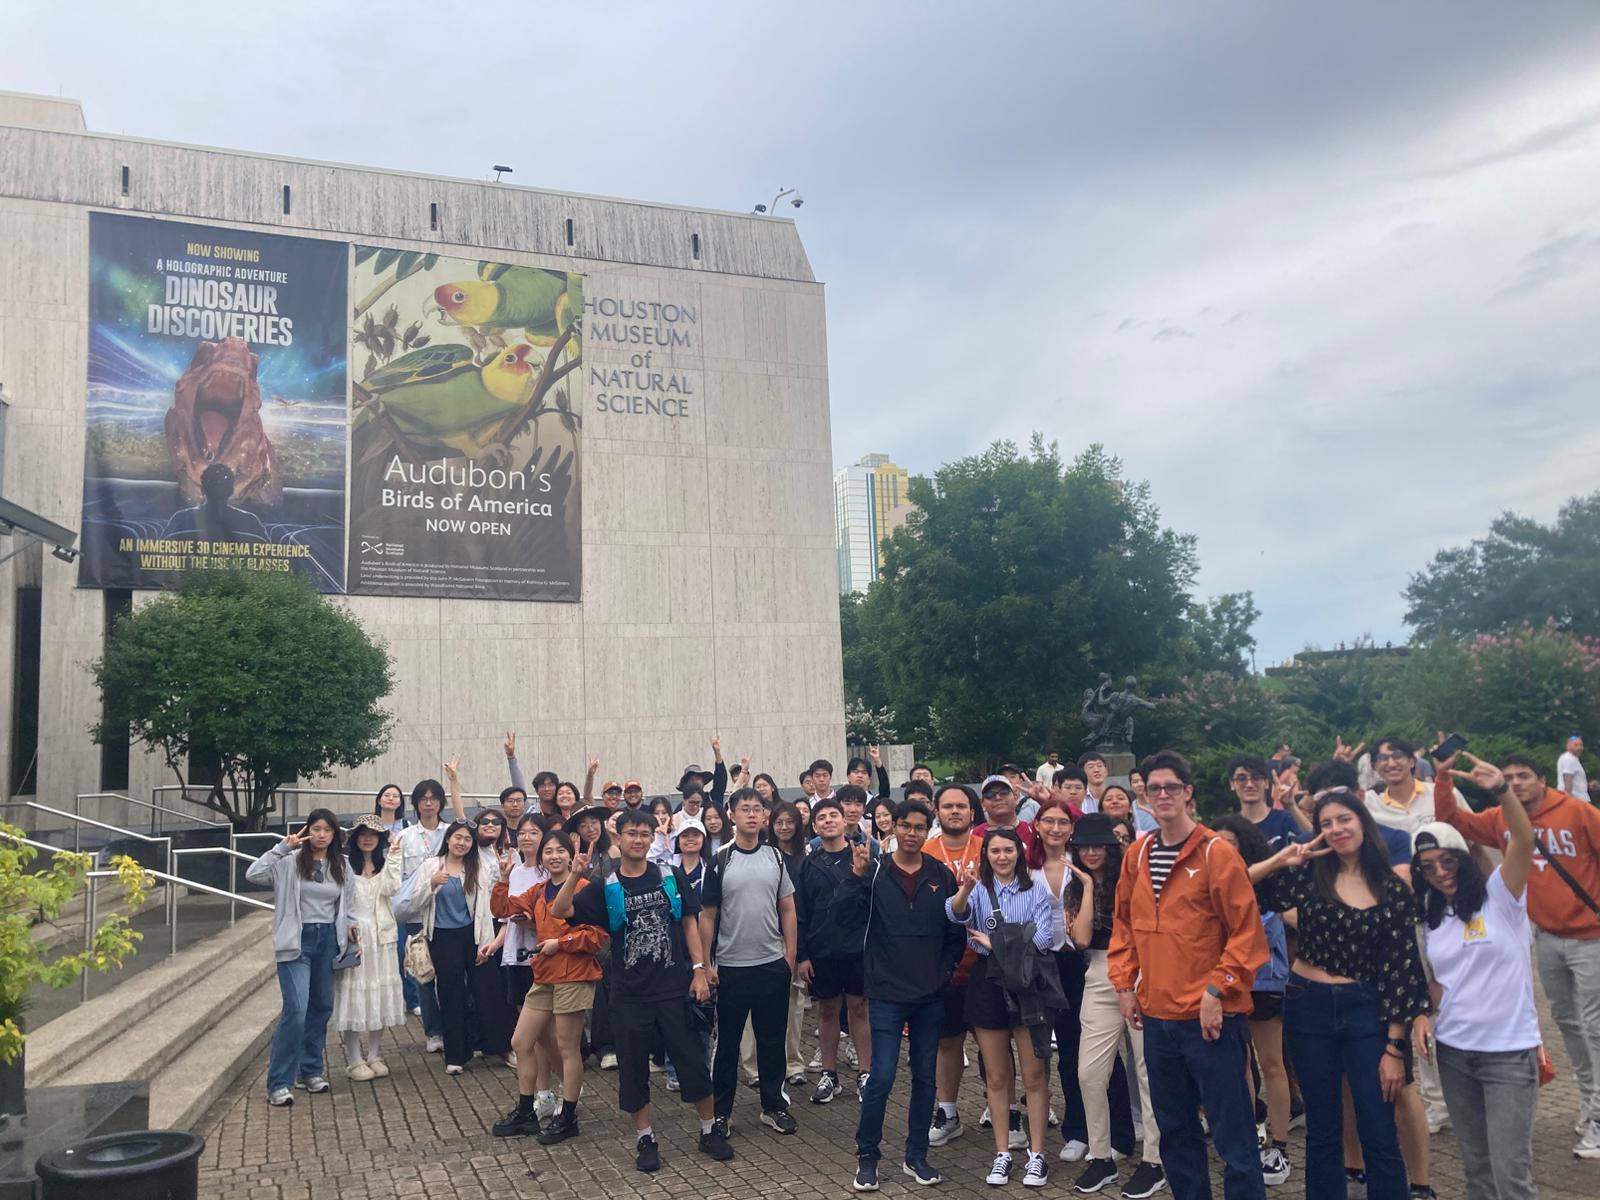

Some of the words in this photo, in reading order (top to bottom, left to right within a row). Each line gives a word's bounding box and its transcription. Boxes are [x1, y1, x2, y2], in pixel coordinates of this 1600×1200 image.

[186, 242, 212, 257] NOW
[213, 246, 260, 262] SHOWING
[156, 258, 163, 270] A
[166, 259, 232, 278] HOLOGRAPHIC
[234, 268, 288, 284] ADVENTURE
[165, 275, 278, 314] DINOSAUR
[581, 296, 696, 324] HOUSTON
[148, 303, 293, 346] DISCOVERIES
[590, 322, 691, 347] MUSEUM
[631, 350, 652, 368] of
[590, 367, 693, 395] NATURAL
[596, 393, 689, 417] SCIENCE
[381, 488, 434, 510] Birds
[441, 493, 463, 510] of
[467, 494, 553, 517] America
[426, 519, 466, 533] NOW
[469, 521, 511, 536] OPEN
[119, 538, 133, 552] AN
[136, 538, 194, 554] IMMERSIVE
[196, 541, 210, 555] 3D
[212, 541, 251, 556] CINEMA
[253, 544, 310, 558] EXPERIENCE
[140, 554, 187, 569] WITHOUT
[189, 555, 208, 569] THE
[246, 558, 290, 572] GLASSES
